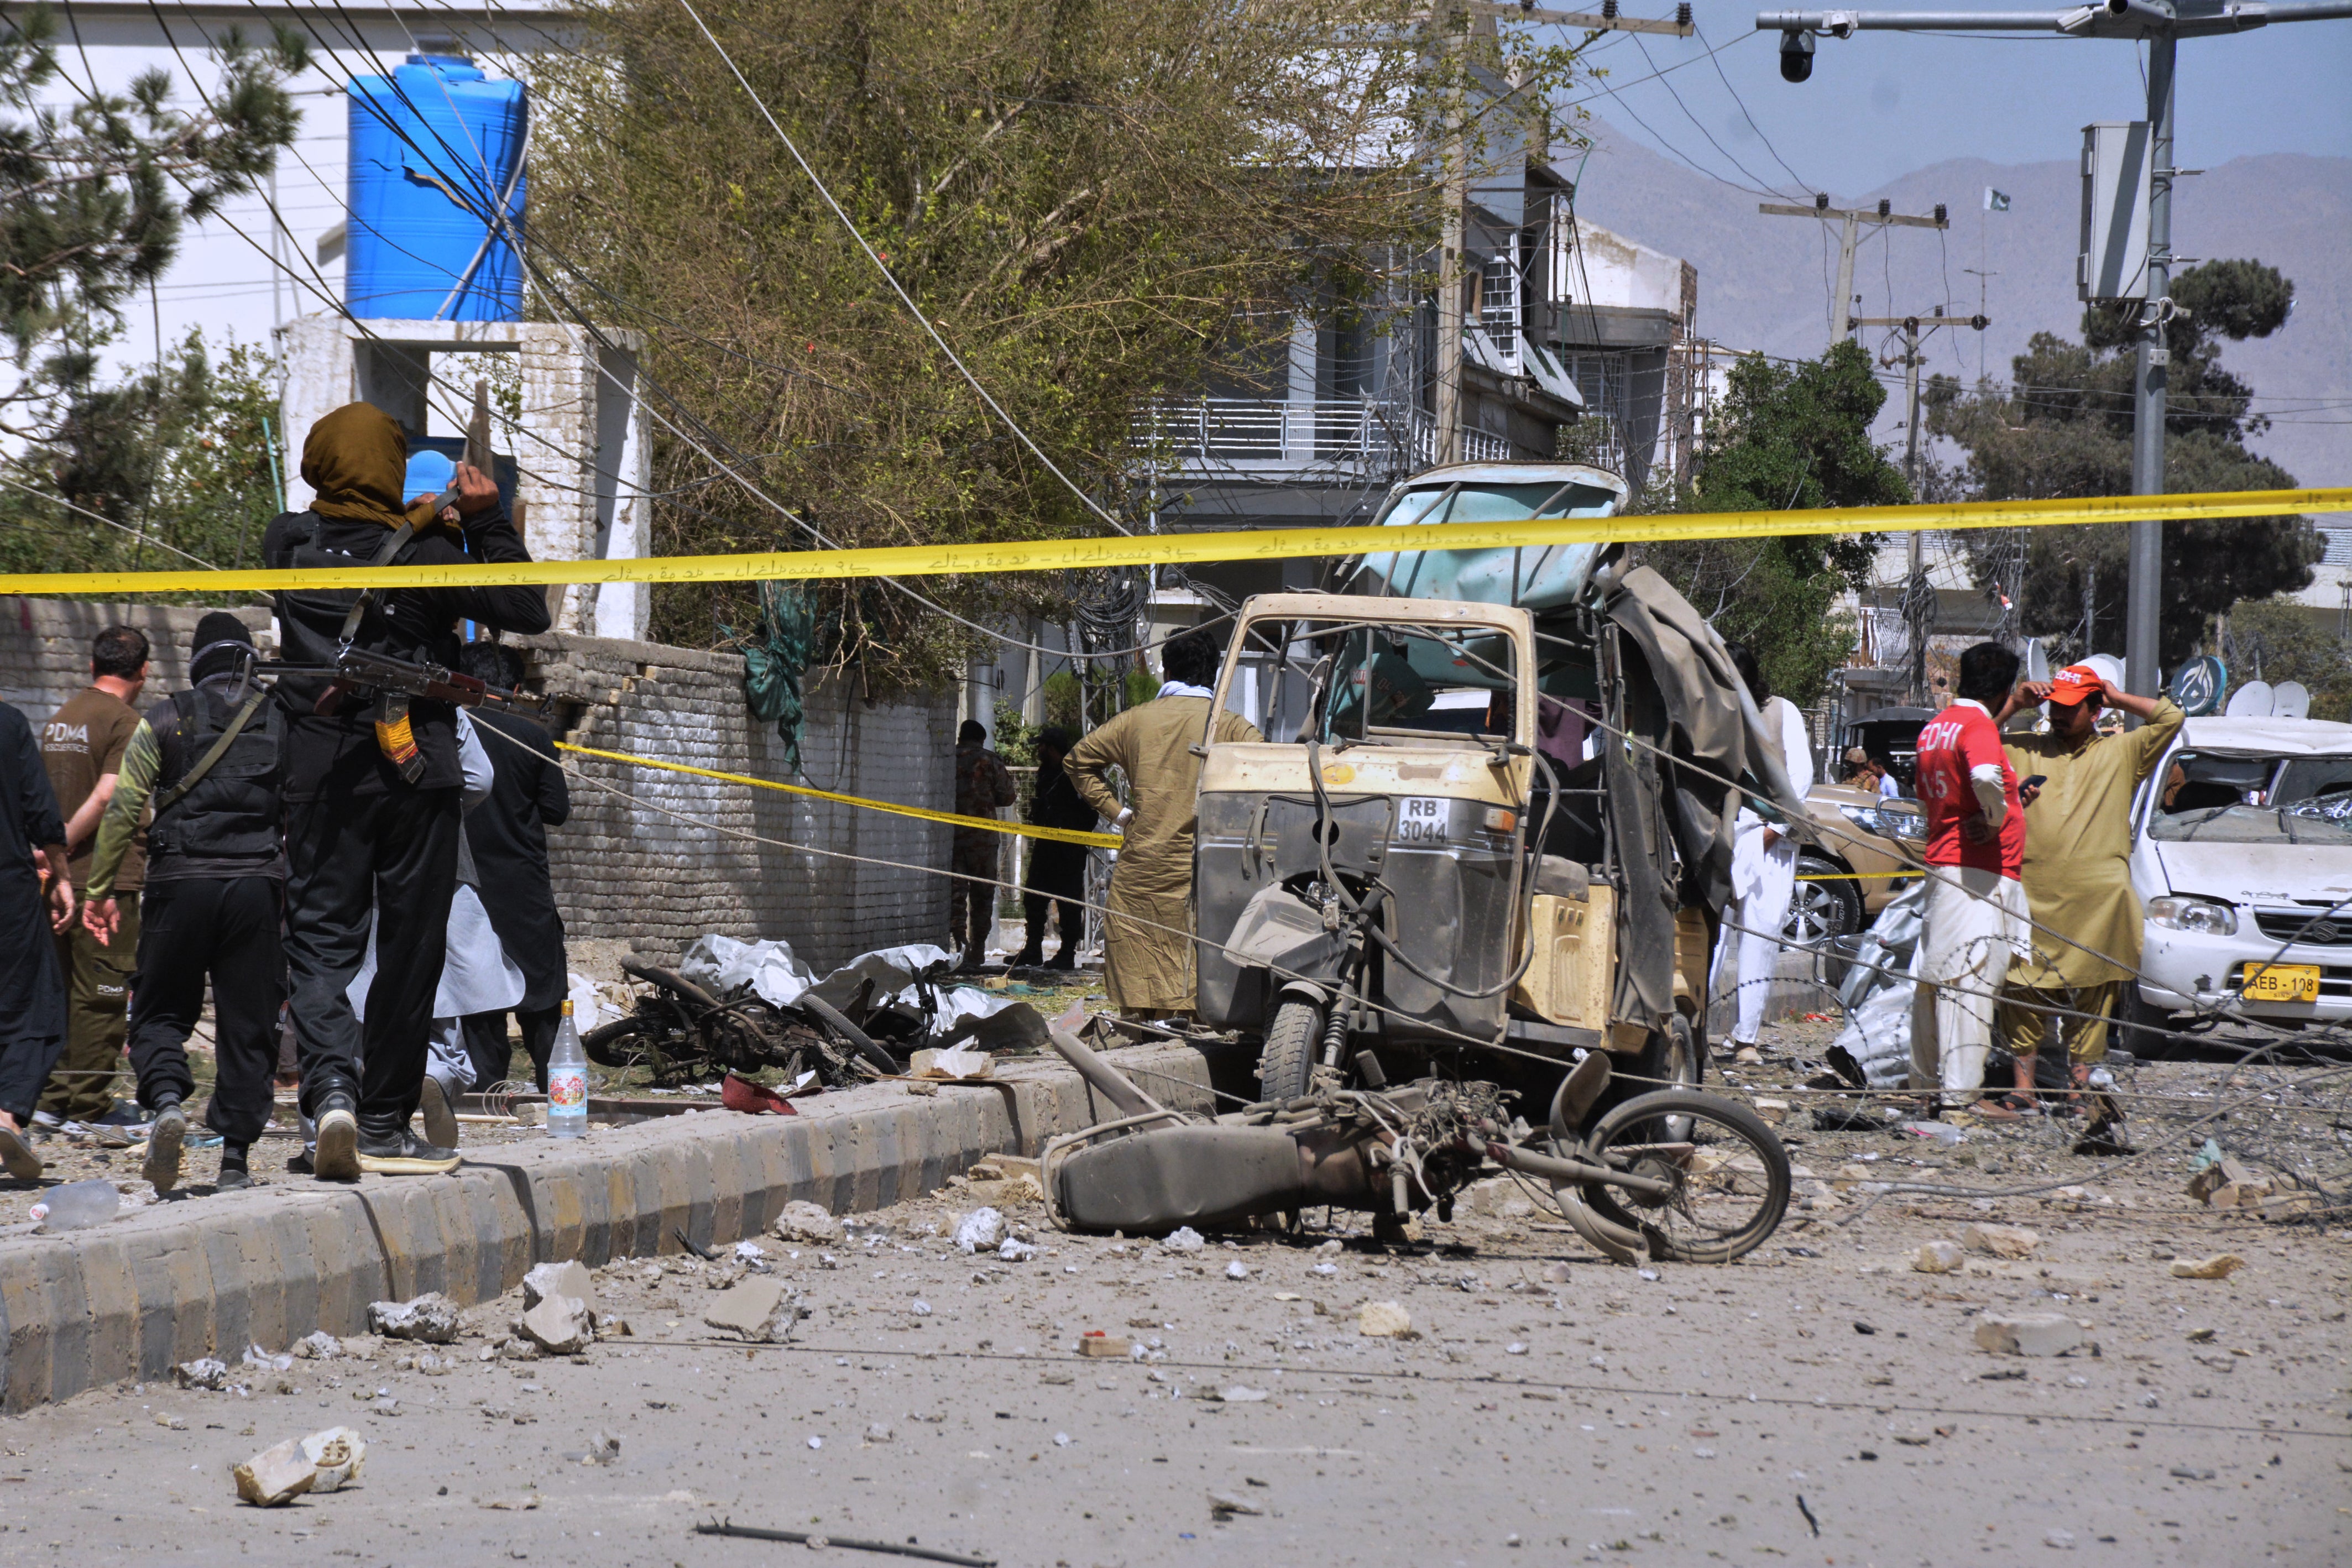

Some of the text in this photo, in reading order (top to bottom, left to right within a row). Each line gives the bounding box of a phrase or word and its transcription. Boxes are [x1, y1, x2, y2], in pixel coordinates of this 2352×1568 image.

[2055, 670, 2082, 684] EDHI
[44, 723, 89, 743] PDMA
[1918, 722, 1963, 752] EDHI
[1409, 799, 1436, 817] RB
[1400, 820, 1446, 843] 3044
[97, 985, 124, 993] PDMA
[2248, 976, 2277, 990] AEB
[2291, 978, 2314, 992] 108
